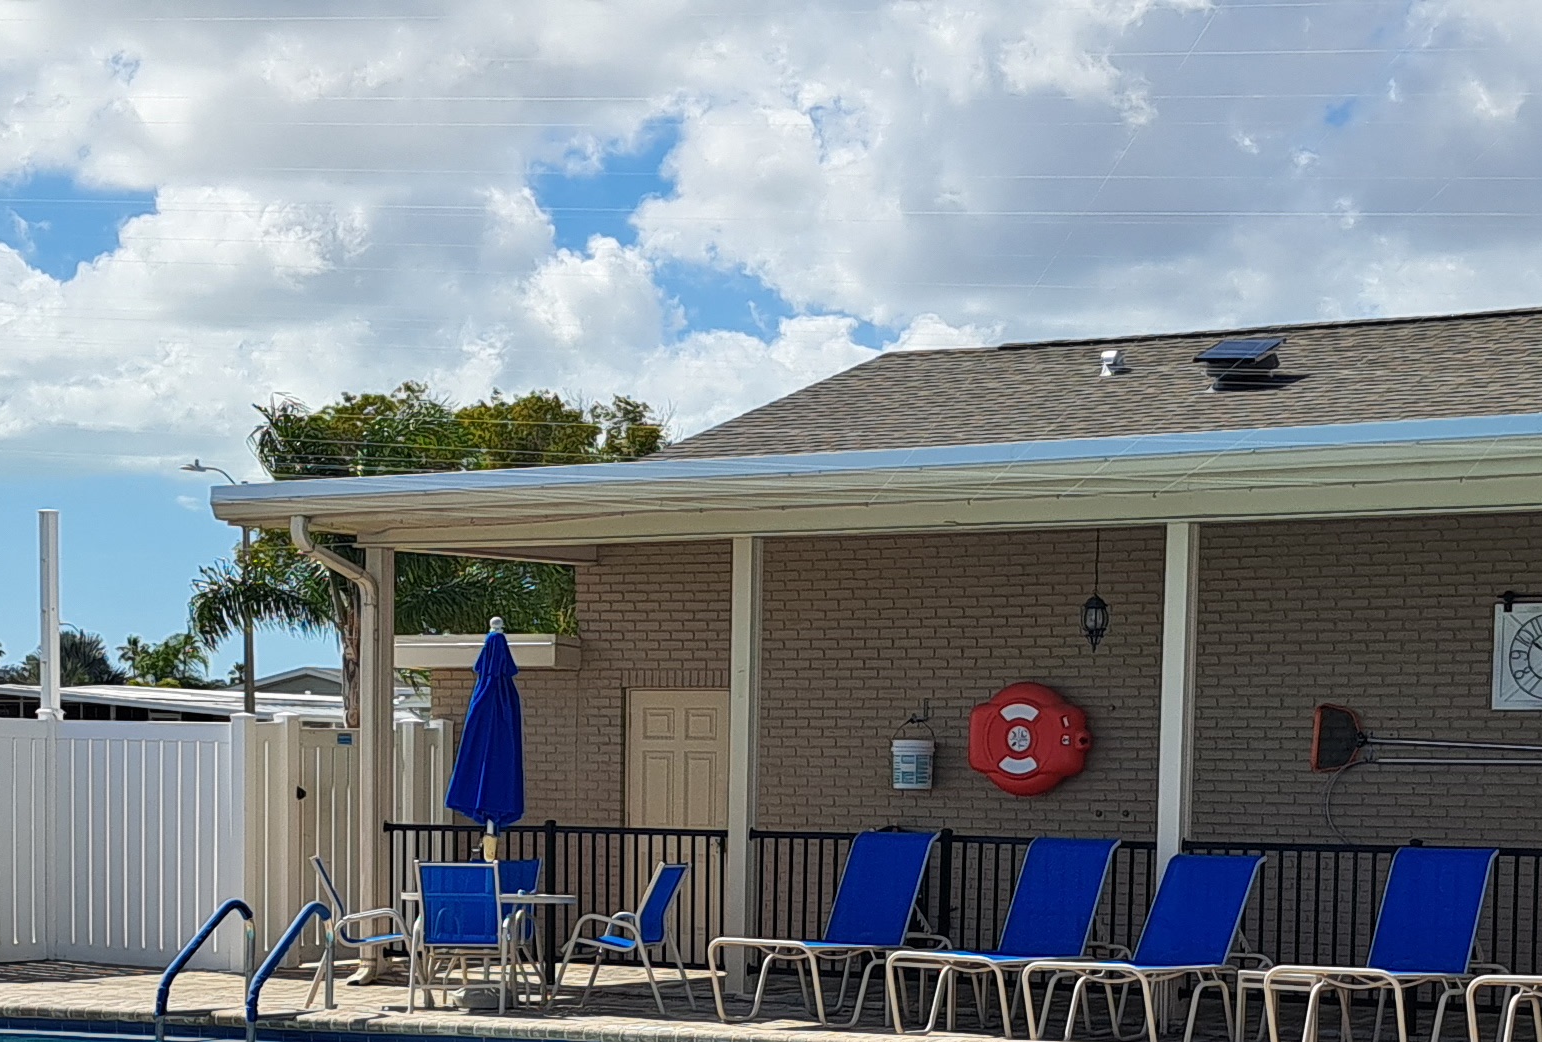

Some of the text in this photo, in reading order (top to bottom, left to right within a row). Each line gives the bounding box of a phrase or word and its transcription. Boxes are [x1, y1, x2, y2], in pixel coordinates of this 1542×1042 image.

[1515, 629, 1535, 647] 10
[1510, 649, 1528, 661] 9
[1514, 666, 1531, 680] 8
